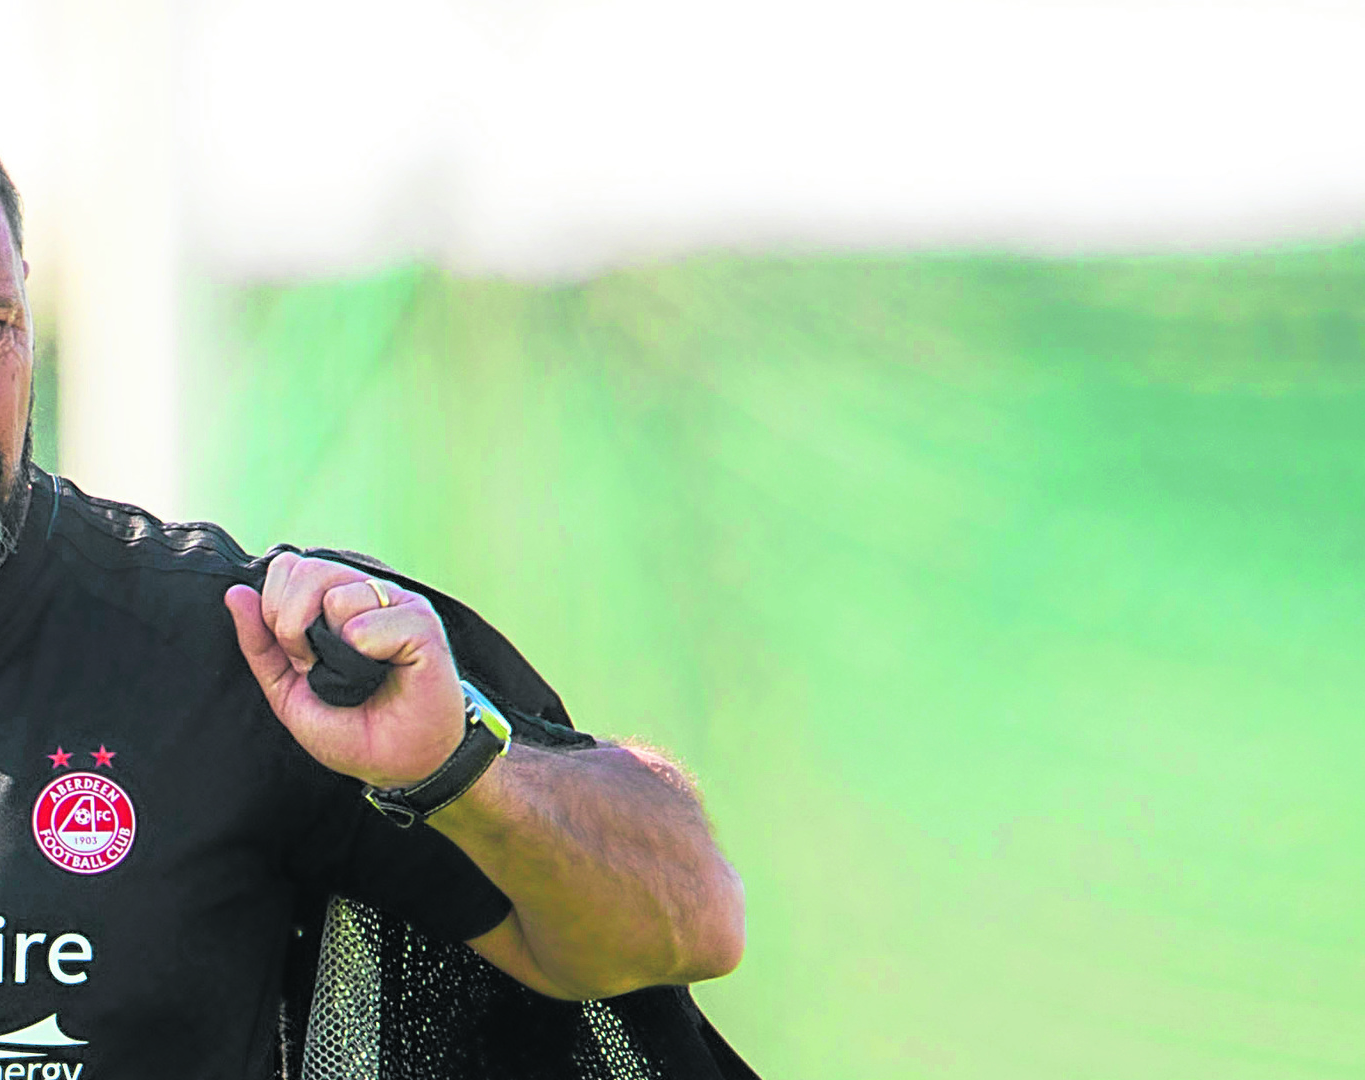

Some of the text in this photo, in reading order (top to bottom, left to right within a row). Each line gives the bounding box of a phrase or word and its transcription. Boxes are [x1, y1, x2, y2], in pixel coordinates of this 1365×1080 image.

[49, 778, 120, 803] ABERDEEN
[40, 827, 131, 869] FOOTBALL CLUB
[74, 836, 98, 845] 1903
